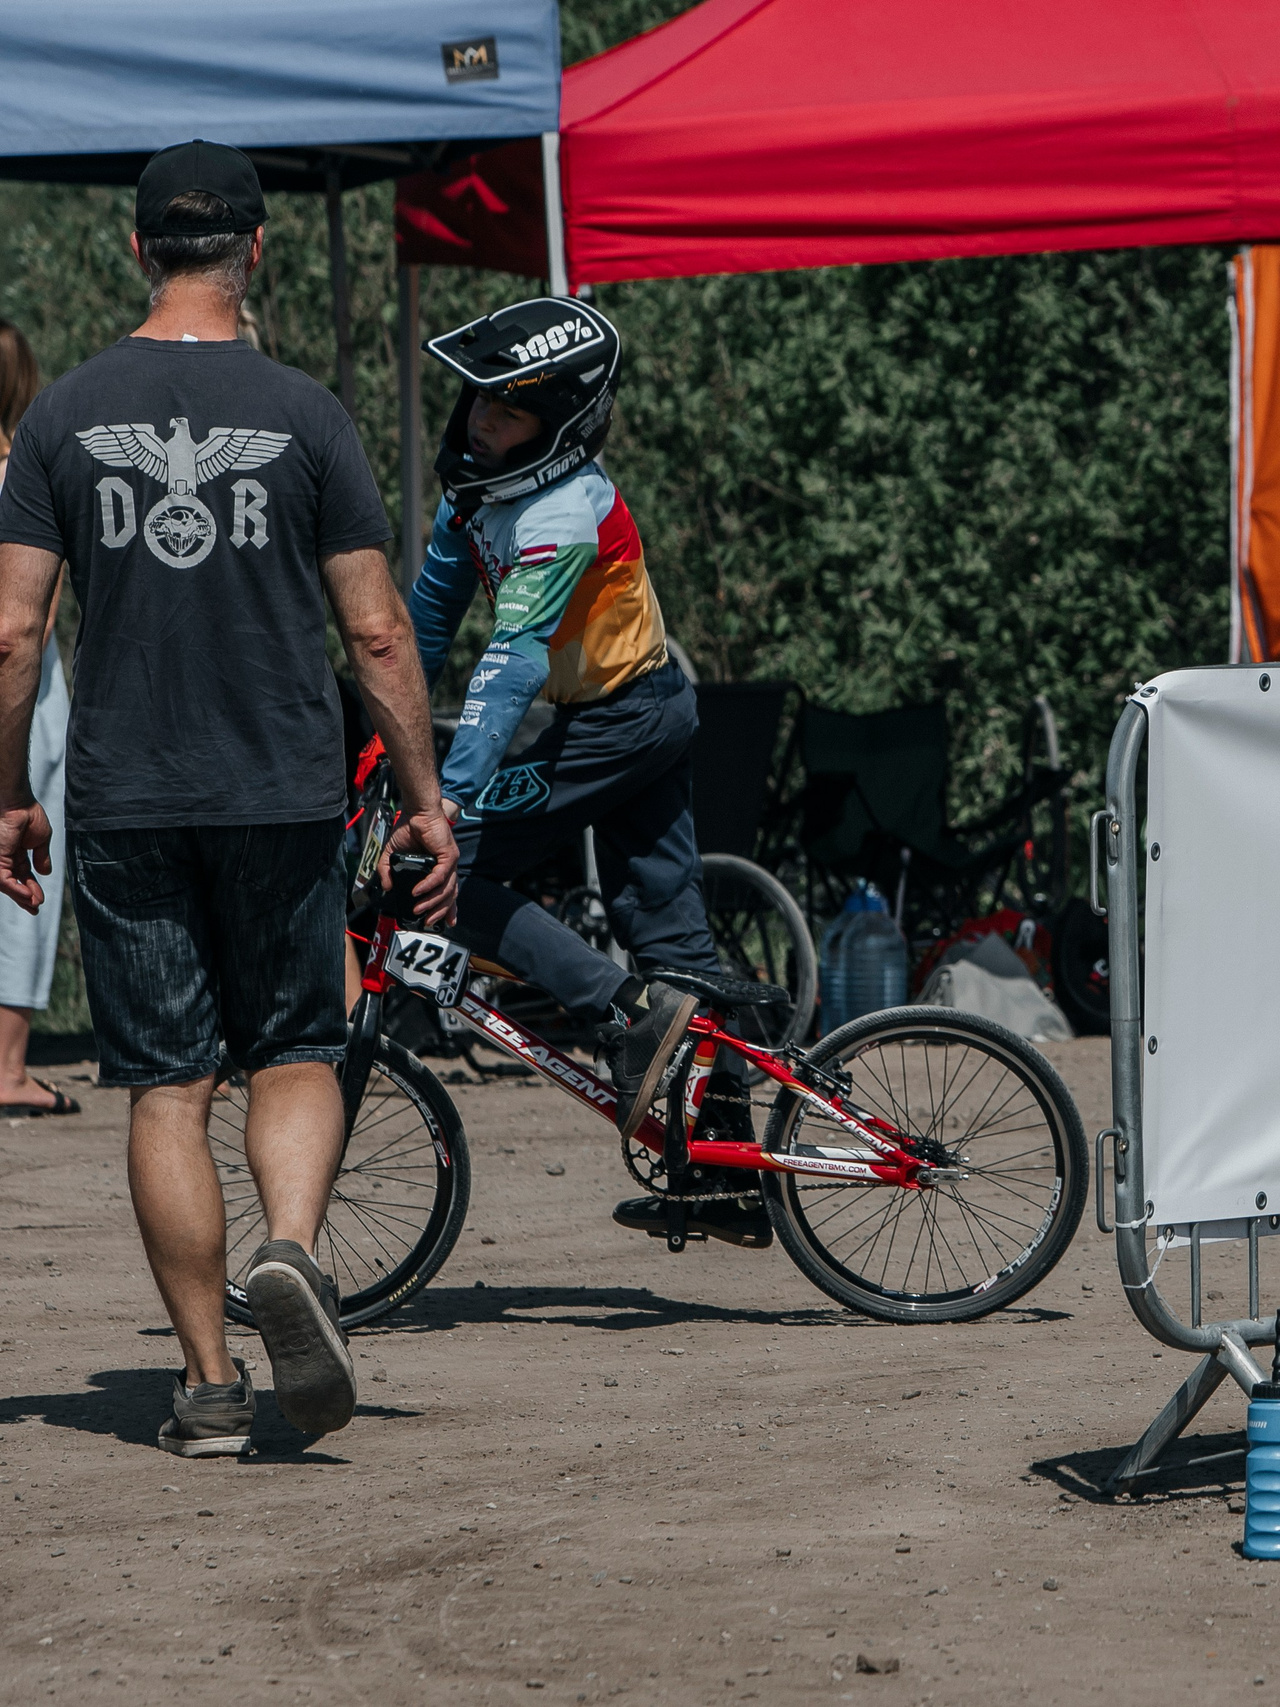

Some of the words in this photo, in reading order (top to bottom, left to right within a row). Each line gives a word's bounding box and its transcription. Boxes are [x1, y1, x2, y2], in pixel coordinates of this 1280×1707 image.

[510, 317, 593, 365] 100%
[544, 451, 580, 482] 100%
[95, 476, 137, 548] D
[229, 478, 270, 550] R
[394, 938, 463, 983] 424
[389, 1273, 419, 1303] MAXXIS
